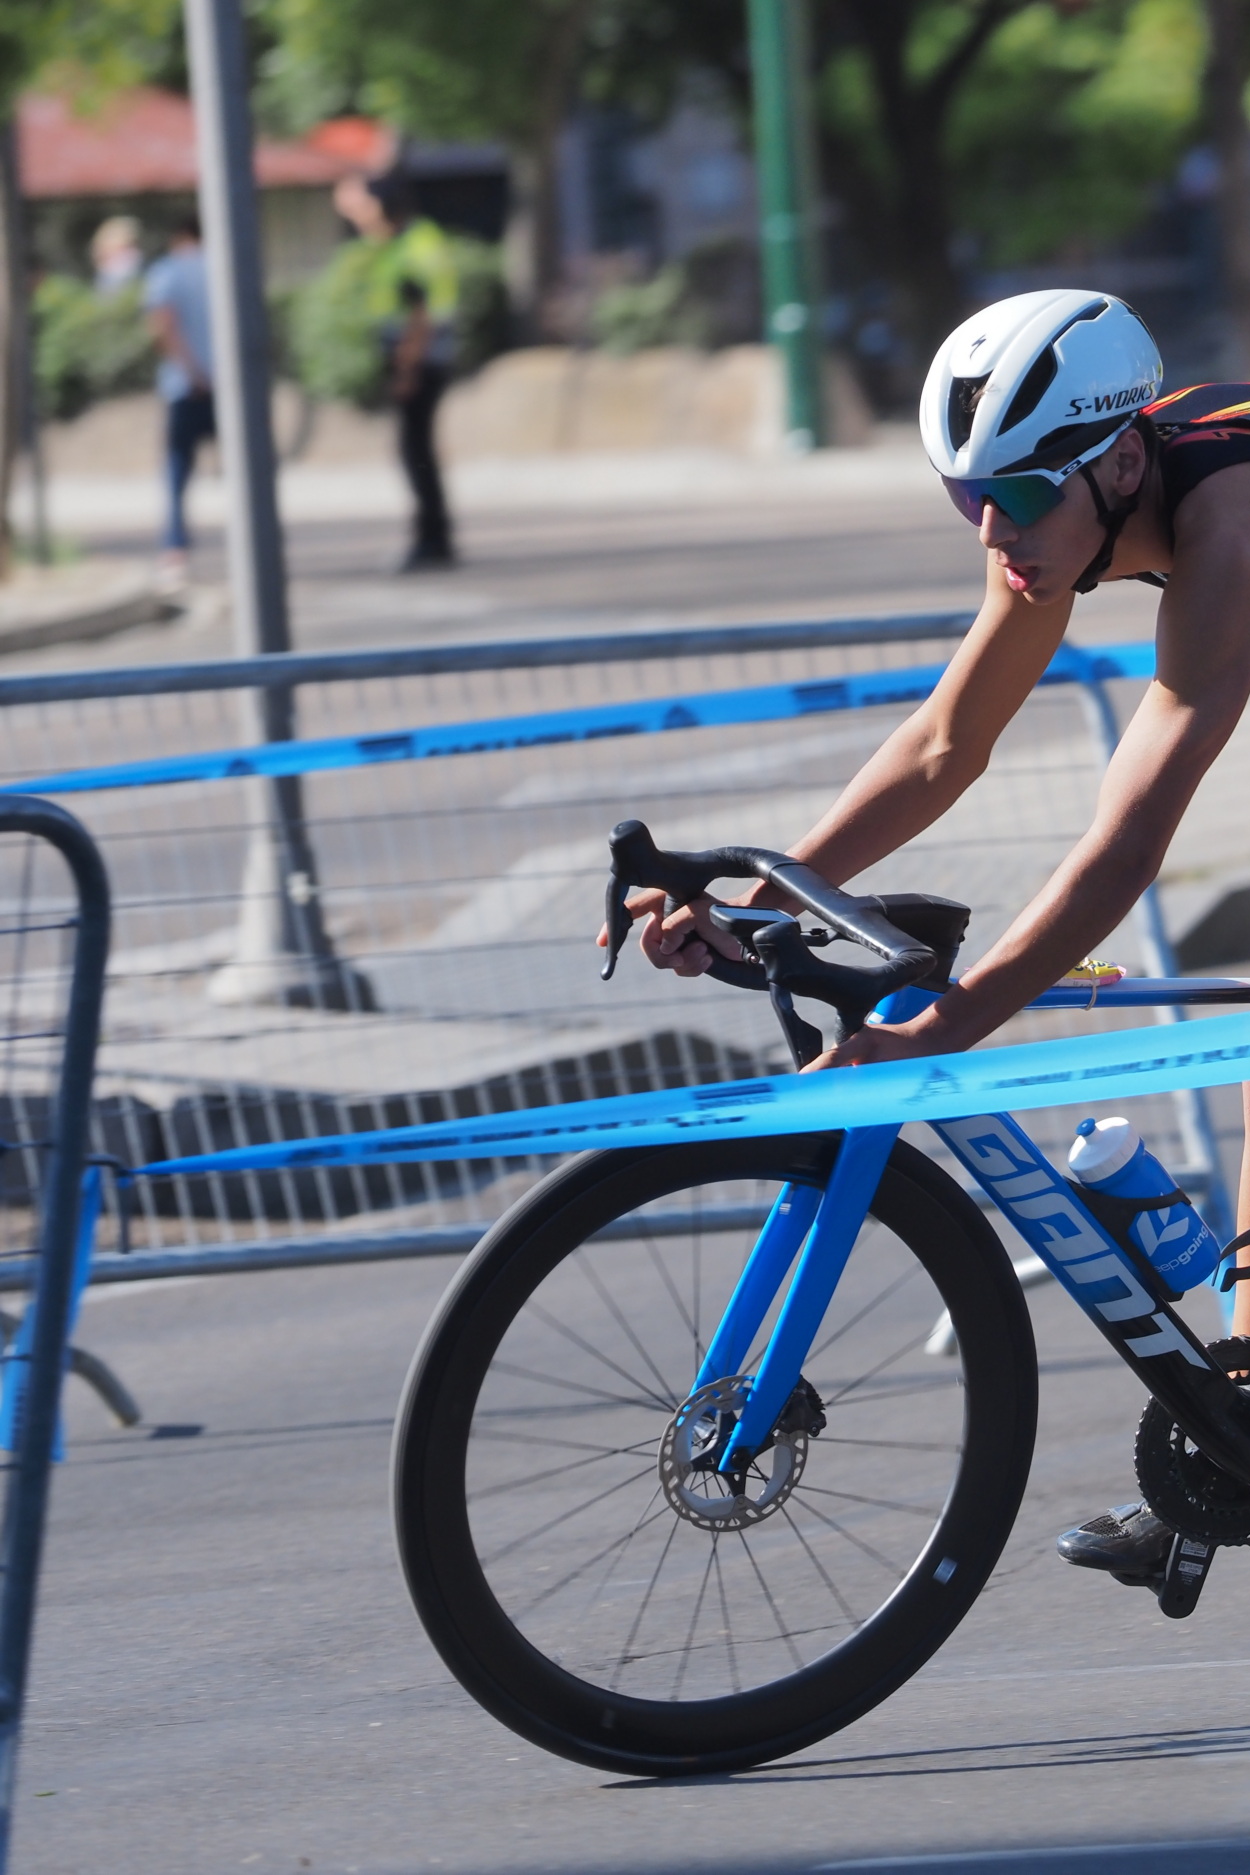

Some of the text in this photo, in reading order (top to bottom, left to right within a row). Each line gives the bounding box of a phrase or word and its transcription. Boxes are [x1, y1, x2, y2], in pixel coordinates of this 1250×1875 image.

[1064, 380, 1157, 418] S-WORKS
[938, 1114, 1212, 1370] GIANT
[1154, 1225, 1208, 1273] eepgoing
